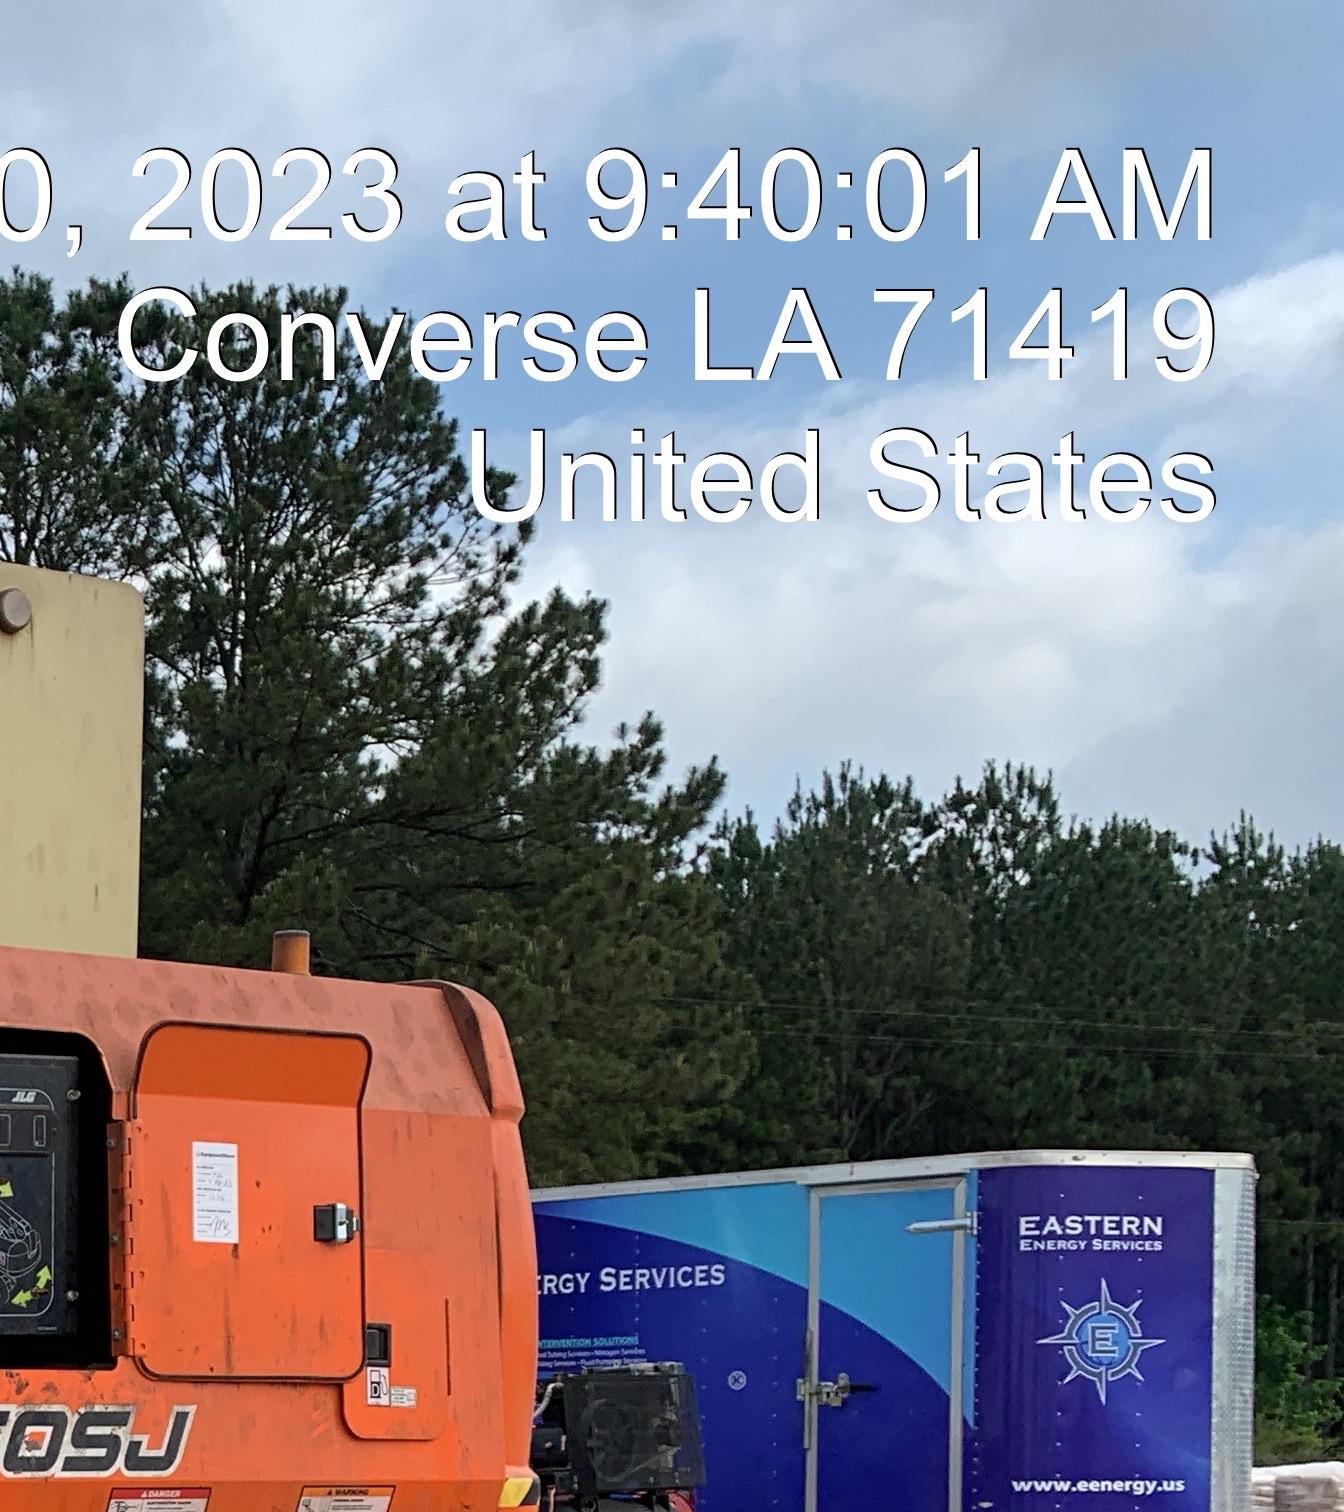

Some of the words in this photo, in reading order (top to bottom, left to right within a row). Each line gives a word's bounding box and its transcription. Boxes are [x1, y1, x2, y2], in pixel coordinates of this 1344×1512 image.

[12, 1091, 37, 1103] JLG
[1019, 1216, 1162, 1236] EASTERN
[1019, 1239, 1088, 1251] ENERGY
[1092, 1238, 1163, 1251] SERVICES
[600, 1263, 726, 1292] SERVICES
[1087, 1323, 1119, 1356] E
[148, 1490, 181, 1498] DANGER
[1011, 1480, 1186, 1496] www.eenergy.us
